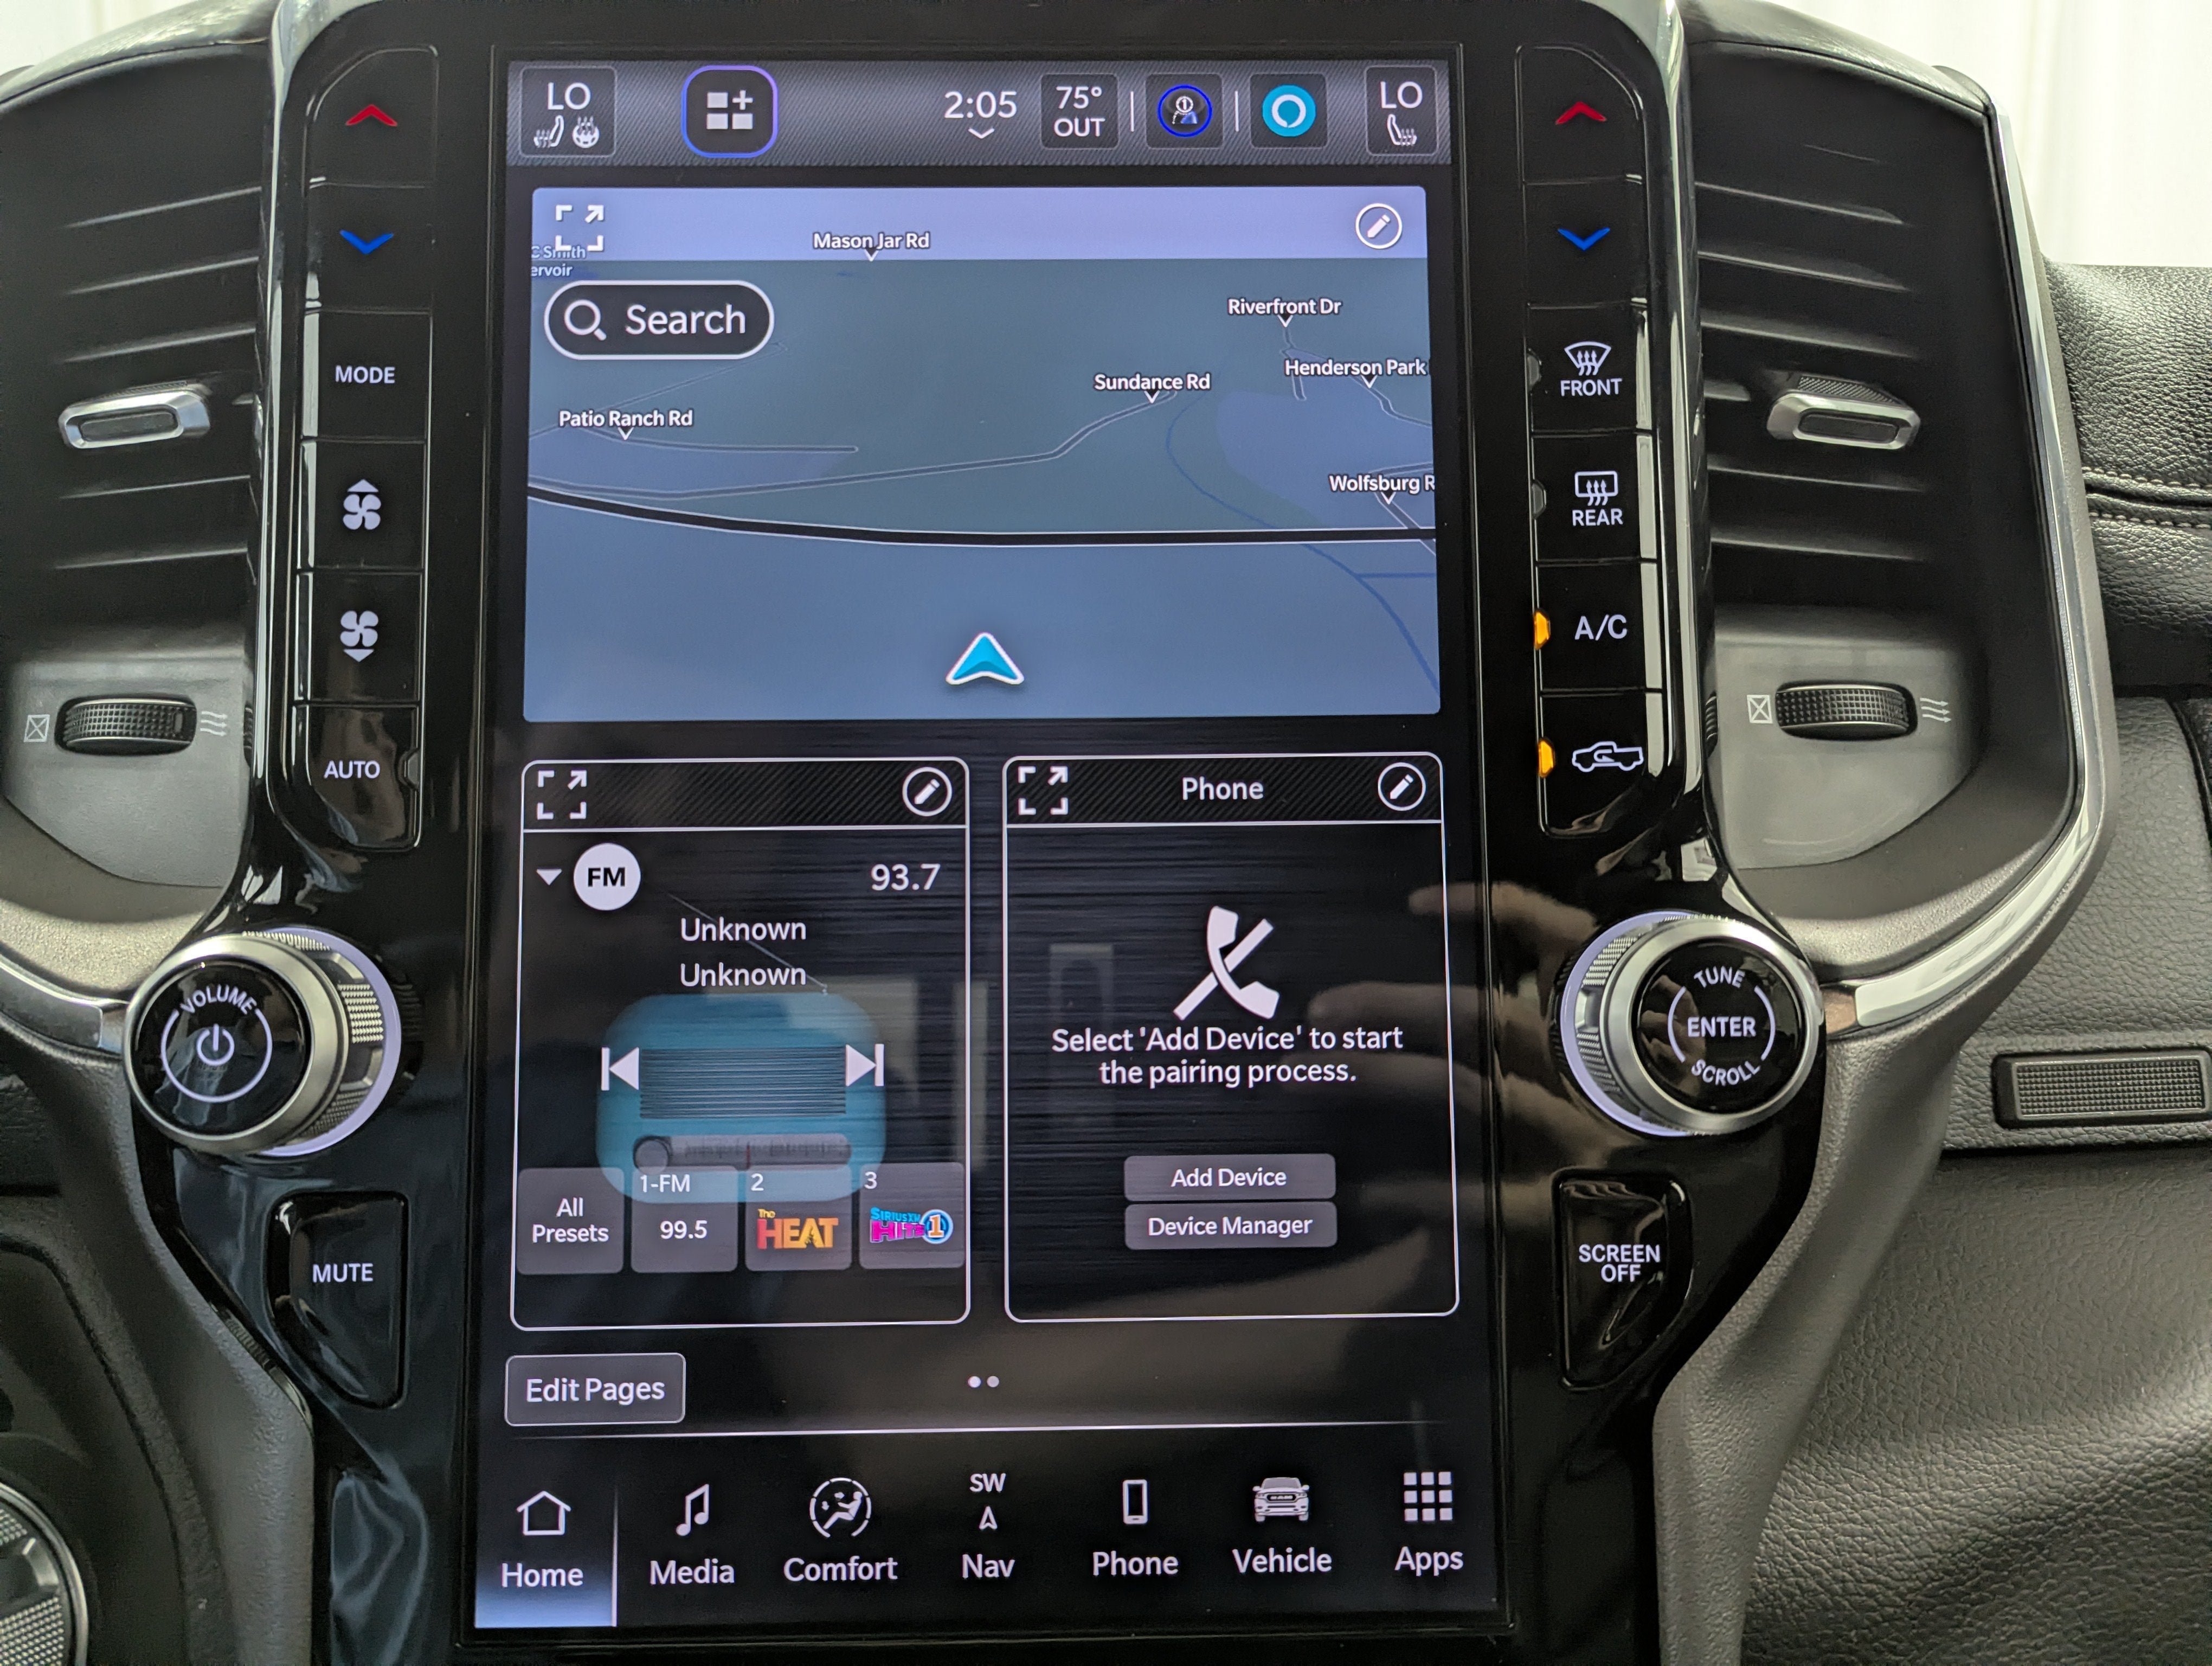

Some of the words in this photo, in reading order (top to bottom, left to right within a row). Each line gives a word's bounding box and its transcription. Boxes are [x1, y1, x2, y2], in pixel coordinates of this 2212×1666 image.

[548, 82, 591, 110] LO
[944, 91, 1017, 119] 2:05
[1056, 86, 1102, 109] 75°
[1380, 81, 1423, 108] LO
[1054, 117, 1105, 138] OUT
[813, 232, 873, 249] Mason
[873, 232, 902, 250] Jar
[905, 232, 930, 249] Rd
[1227, 298, 1316, 315] Riverfront
[1320, 298, 1342, 315] Dr
[625, 304, 747, 336] Search
[335, 366, 396, 385] MODE
[1285, 358, 1382, 376] Henderson
[1386, 358, 1426, 376] Park
[1094, 374, 1184, 390] Sundance
[1187, 373, 1211, 389] Rd
[1560, 377, 1623, 397] FRONT
[559, 410, 605, 427] Patio
[608, 409, 665, 427] Ranch
[668, 409, 693, 426] Rd
[1329, 474, 1420, 495] Wolfsburg
[1572, 508, 1623, 527] REAR
[1574, 613, 1627, 640] A/C
[324, 760, 381, 779] AUTO
[1181, 777, 1264, 801] Phone
[587, 867, 626, 887] FM
[870, 863, 941, 892] 93.7
[680, 917, 807, 942] Unknown
[680, 963, 806, 988] Unknown
[1693, 965, 1746, 989] TUNE
[179, 984, 258, 1016] VOLUME
[1687, 1016, 1757, 1038] ENTER
[1052, 1028, 1133, 1053] Select
[1139, 1027, 1199, 1052] 'Add
[1206, 1025, 1302, 1051] Device'
[1309, 1028, 1336, 1050] to
[1342, 1026, 1404, 1050] start
[1099, 1061, 1143, 1085] the
[1149, 1060, 1241, 1088] pairing
[1248, 1063, 1357, 1088] process.
[1691, 1059, 1761, 1087] SCROLL
[640, 1173, 691, 1193] 1-FM
[750, 1172, 764, 1191] 2
[864, 1170, 878, 1190] 3
[1171, 1168, 1213, 1187] Add
[1218, 1167, 1287, 1187] Device
[556, 1197, 584, 1218] All
[532, 1223, 609, 1244] Presets
[660, 1220, 708, 1240] 99.5
[757, 1217, 839, 1250] HEAT
[928, 1214, 945, 1238] 1
[1148, 1216, 1218, 1236] Device
[1221, 1215, 1313, 1239] Manager
[1578, 1244, 1661, 1263] SCREEN
[312, 1263, 374, 1284] MUTE
[1600, 1264, 1642, 1283] OFF
[526, 1378, 580, 1403] Edit
[585, 1377, 665, 1406] Pages
[969, 1472, 1006, 1492] SW
[649, 1558, 736, 1585] Media
[783, 1555, 898, 1582] Comfort
[961, 1553, 1015, 1579] Nav
[1091, 1550, 1179, 1576] Phone
[1232, 1546, 1333, 1574] Vehicle
[1393, 1545, 1464, 1577] Apps
[501, 1561, 584, 1588] Home
